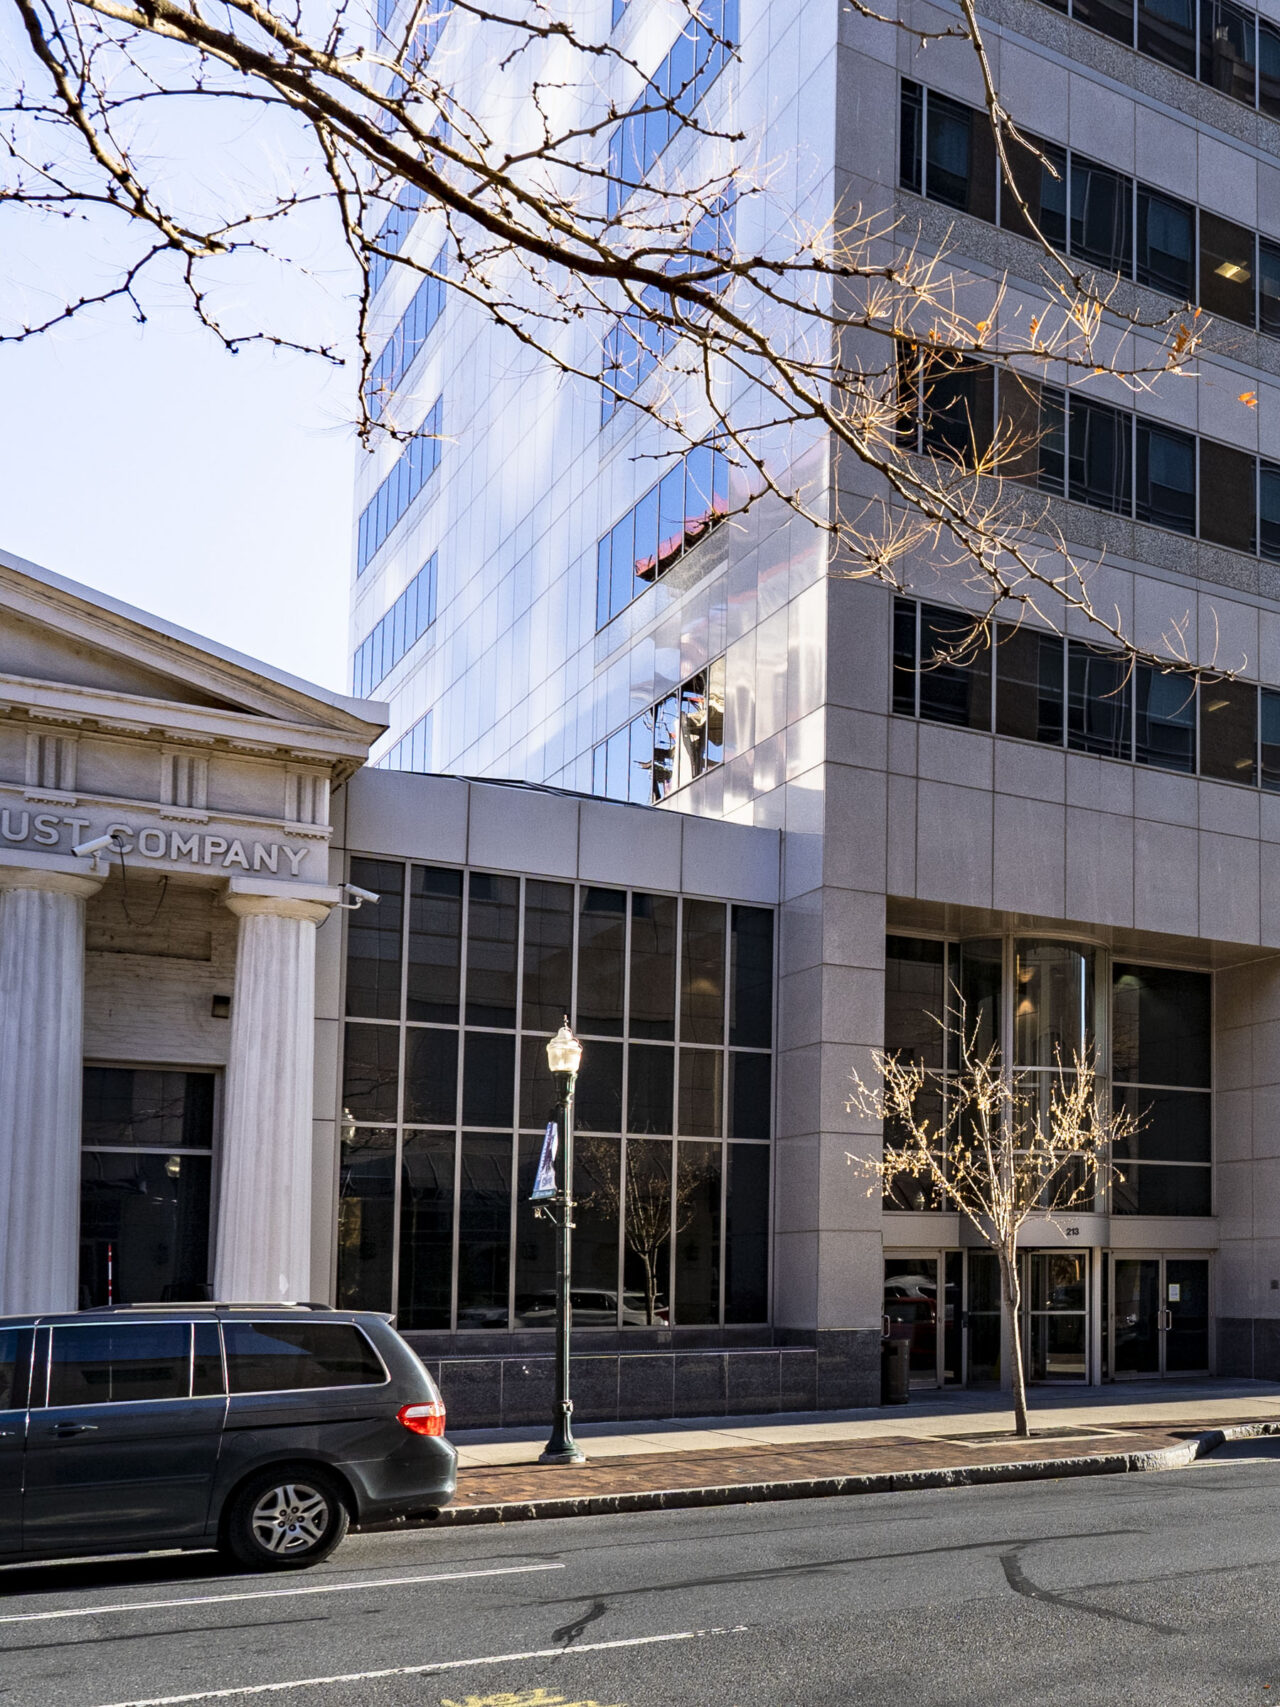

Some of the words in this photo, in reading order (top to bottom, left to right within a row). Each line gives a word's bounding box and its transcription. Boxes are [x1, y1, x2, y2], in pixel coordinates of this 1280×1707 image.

[1, 808, 90, 850] UST
[105, 822, 309, 876] COMPANY
[1066, 1228, 1080, 1236] 213
